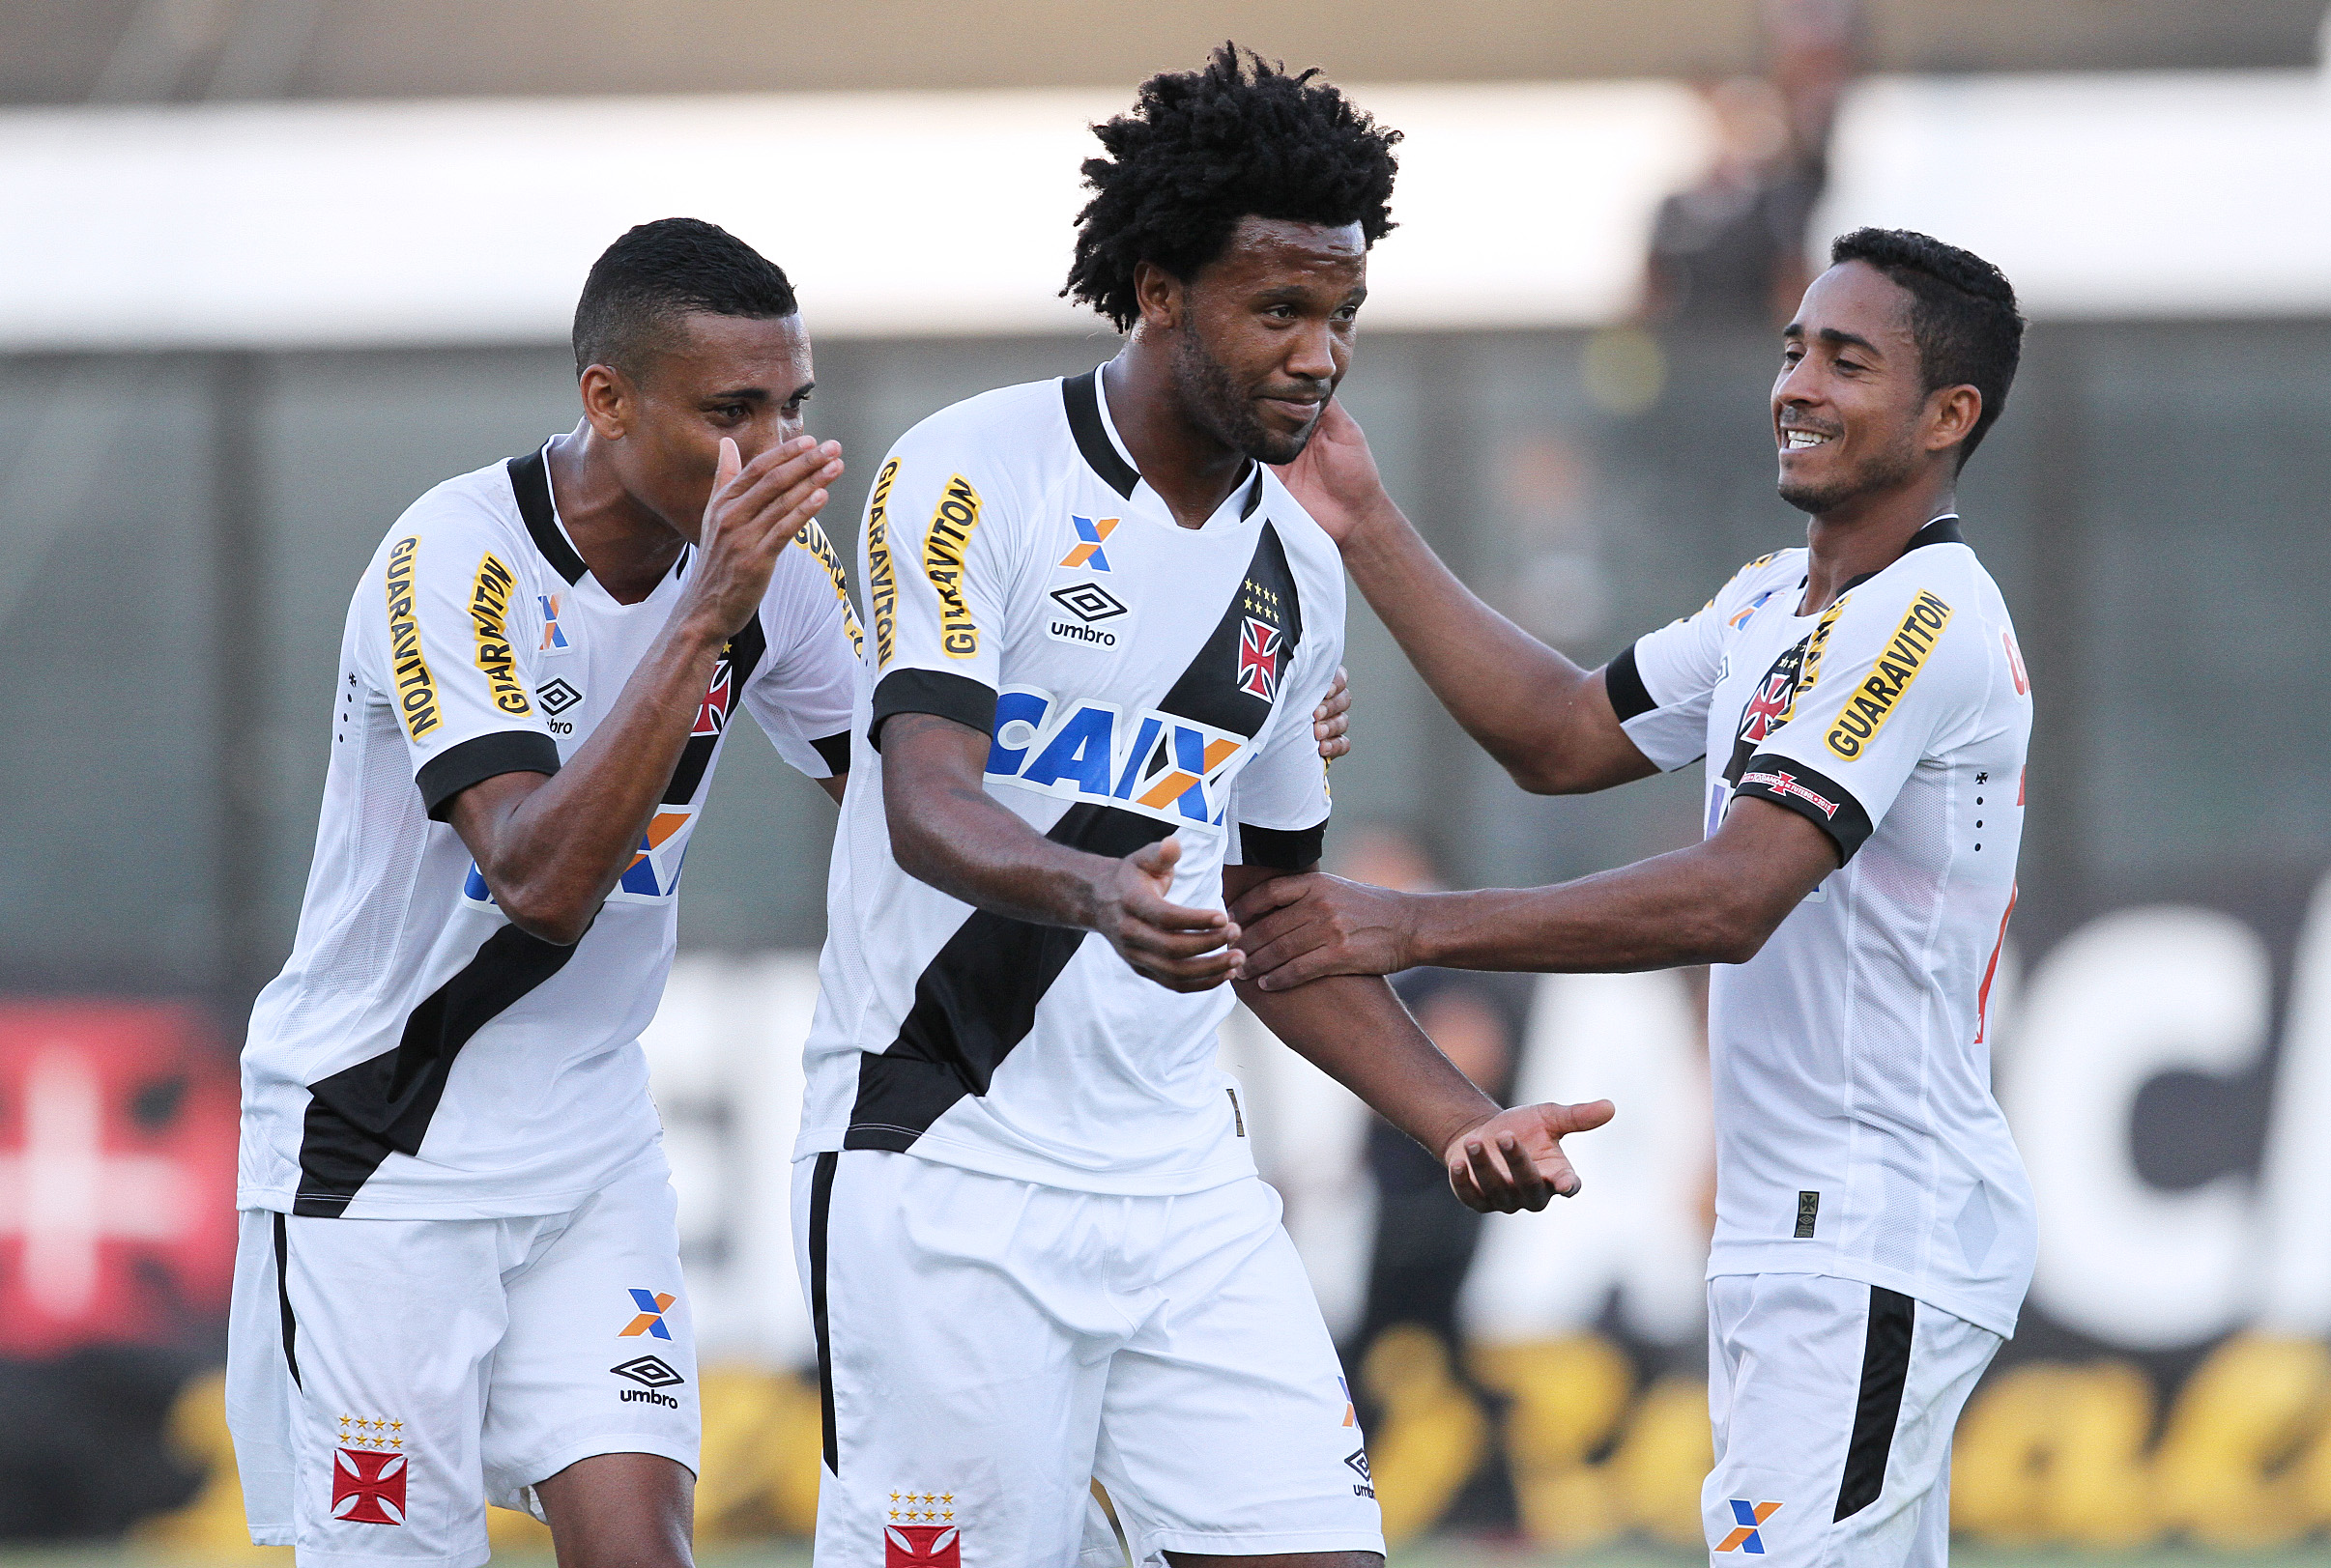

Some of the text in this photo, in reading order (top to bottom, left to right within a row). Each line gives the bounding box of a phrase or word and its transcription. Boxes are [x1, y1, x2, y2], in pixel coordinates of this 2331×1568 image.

[869, 461, 898, 668] GUARAVITON
[387, 537, 438, 737] GUARAVITON
[1050, 621, 1116, 646] umbro
[1827, 590, 1951, 757] GUARAVITON
[546, 718, 573, 734] bro
[984, 691, 1243, 828] CAIX
[619, 1388, 678, 1410] umbro
